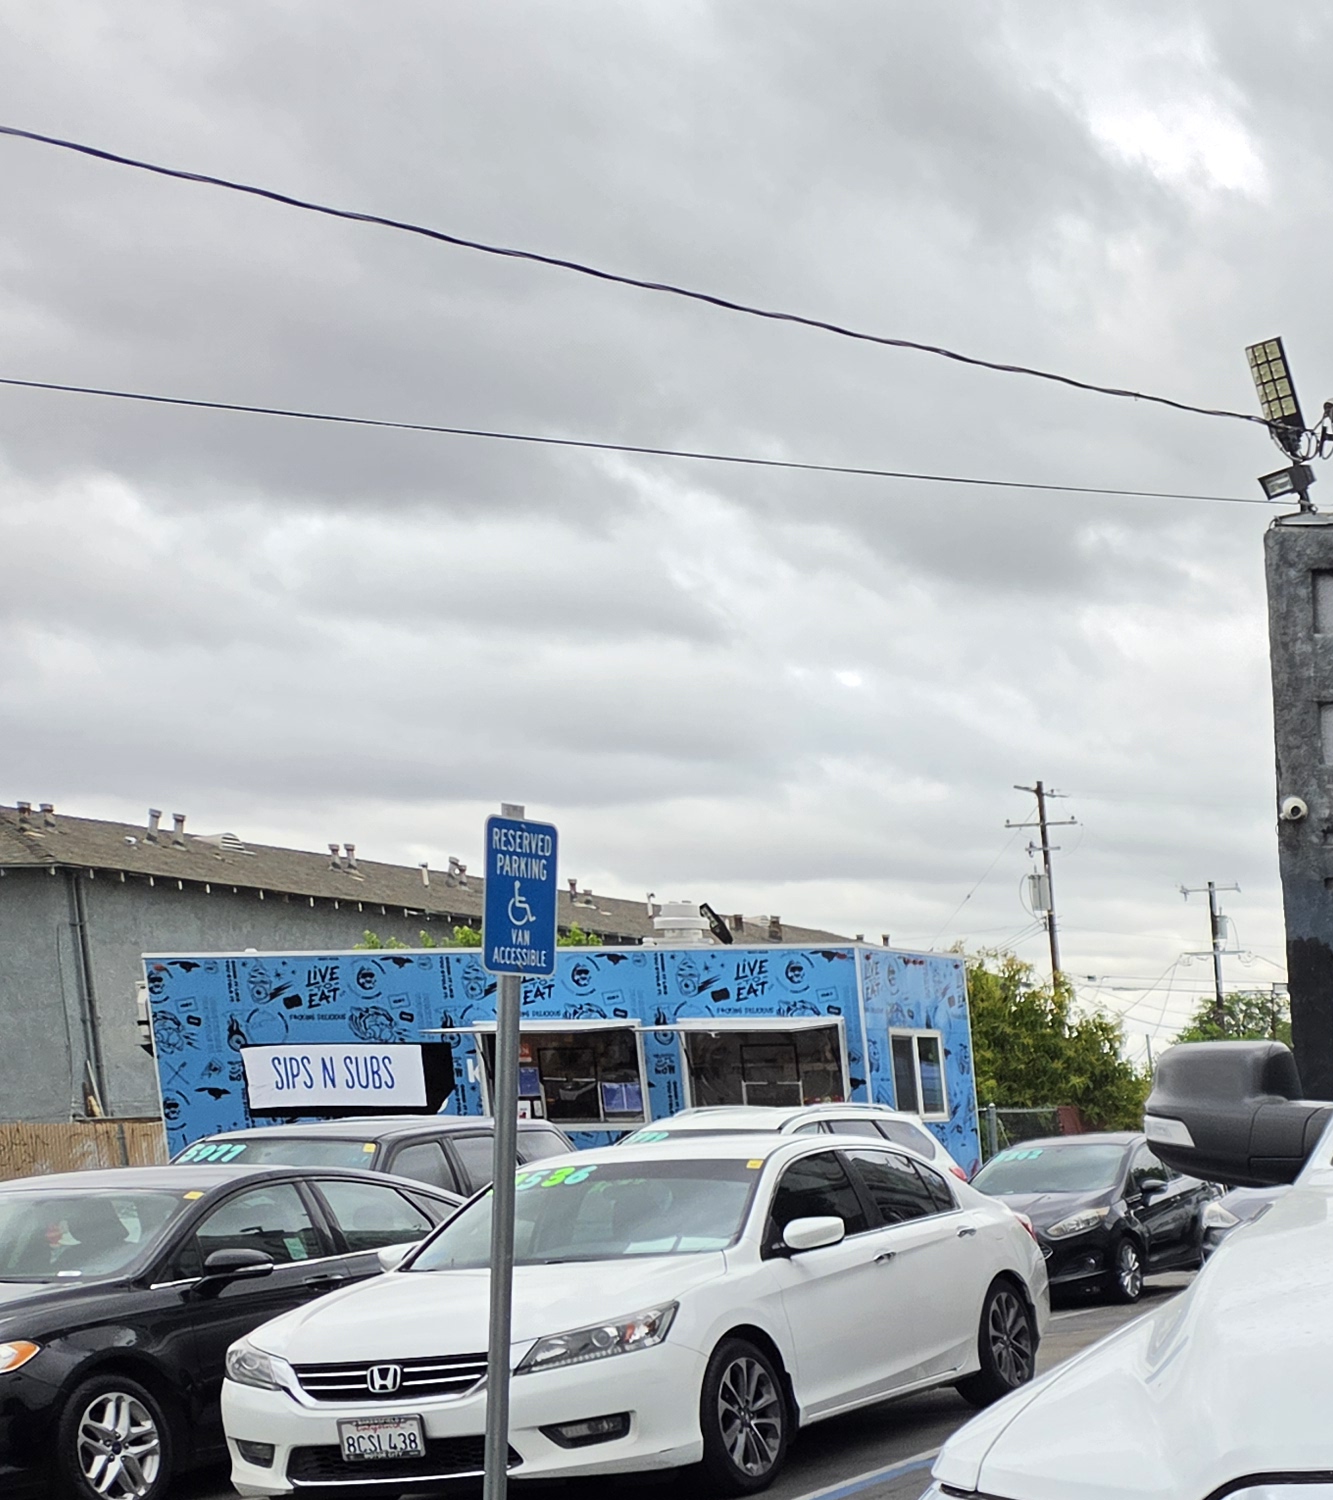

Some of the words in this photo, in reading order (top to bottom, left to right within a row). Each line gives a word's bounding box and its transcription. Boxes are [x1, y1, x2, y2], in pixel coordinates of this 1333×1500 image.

[492, 827, 552, 856] RESERVED
[496, 854, 547, 881] PARKING
[511, 928, 530, 946] VAN
[492, 946, 547, 967] ACCESSIBLE
[307, 987, 340, 1009] EAT
[522, 984, 555, 1005] EAT
[735, 981, 768, 1002] EAT
[271, 1056, 314, 1090] SIPS
[321, 1056, 337, 1089] N
[343, 1055, 395, 1089] SUBS
[515, 1165, 598, 1191] 536
